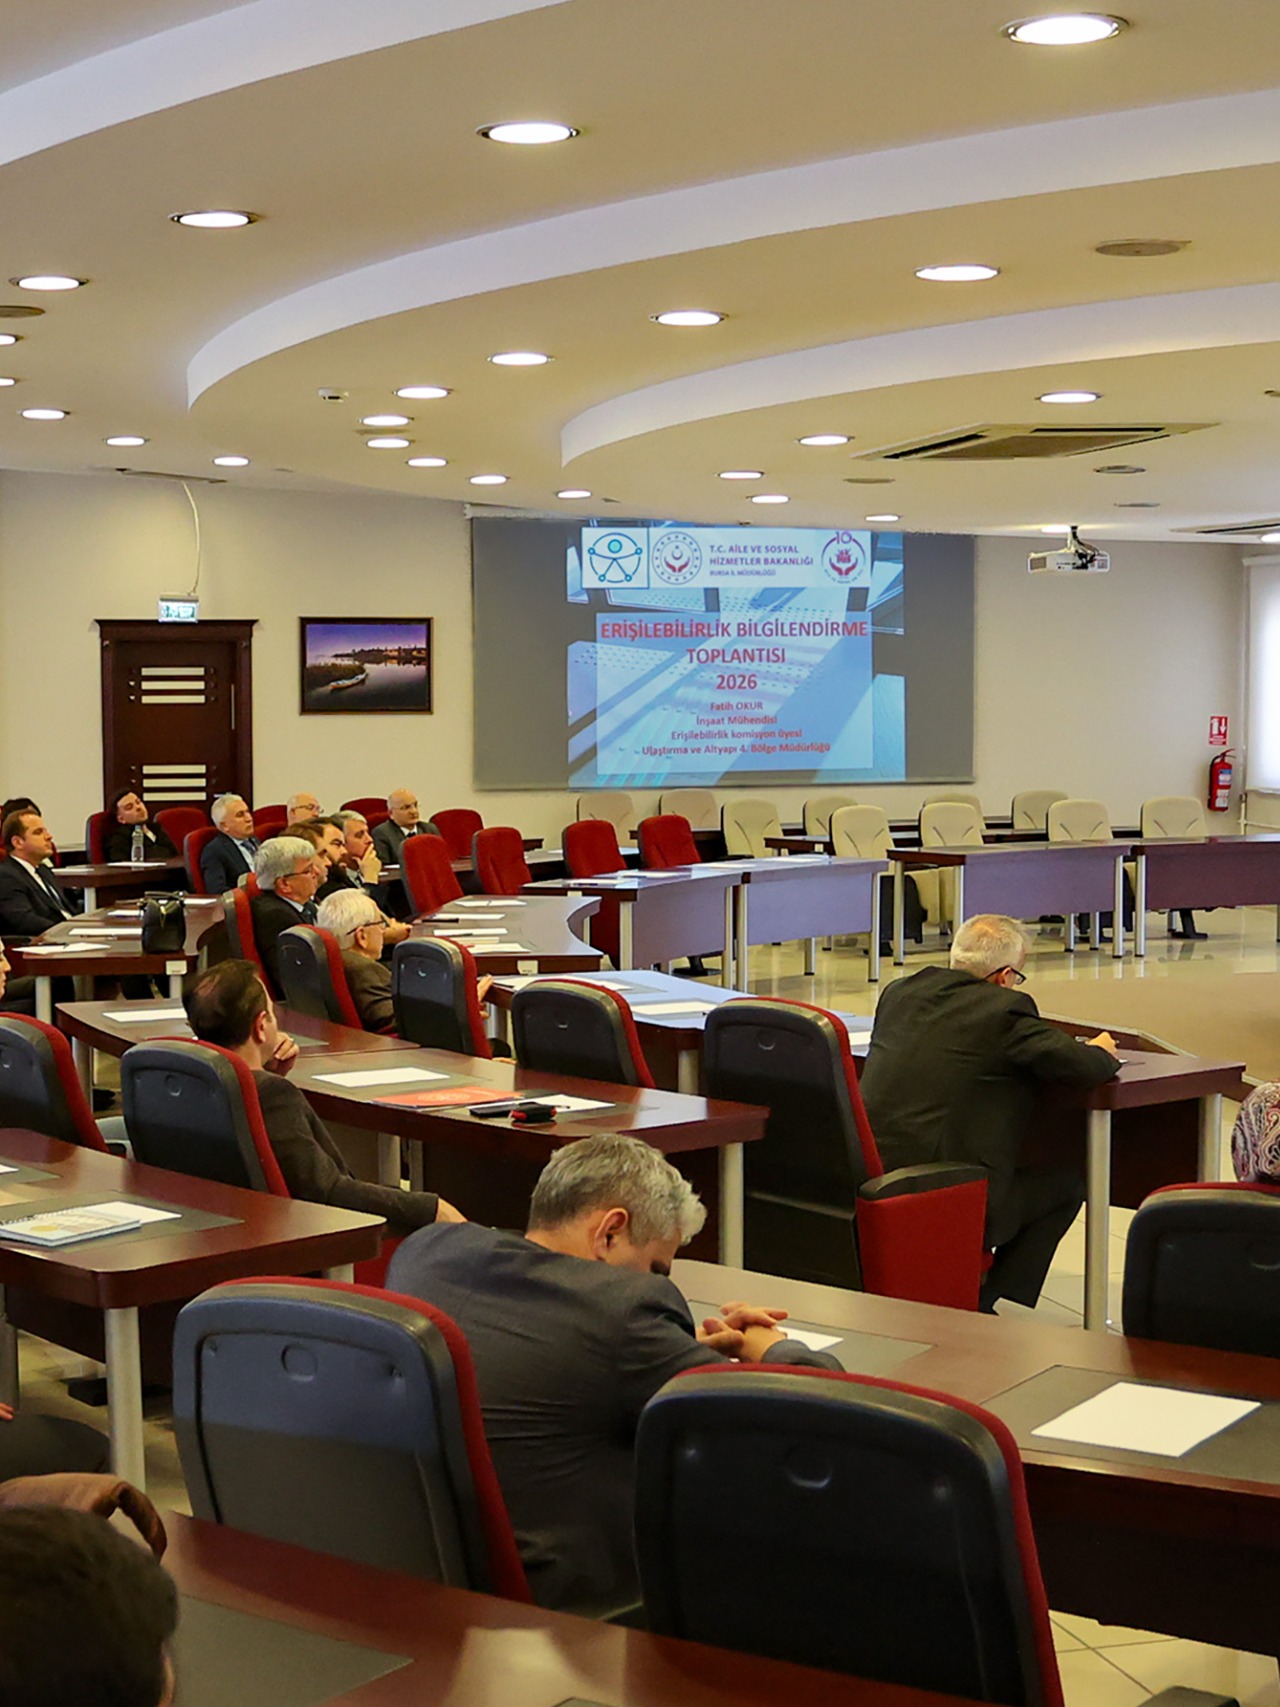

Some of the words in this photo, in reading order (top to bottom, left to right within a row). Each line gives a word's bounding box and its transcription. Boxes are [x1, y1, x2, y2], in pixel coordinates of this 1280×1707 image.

[709, 545, 726, 553] T.C.
[728, 543, 748, 553] AİLE
[750, 545, 762, 553] VE
[764, 545, 799, 553] SOSYAL
[709, 556, 761, 565] HİZMETLER
[763, 555, 814, 565] BAKANLIĞI
[601, 619, 731, 641] ERİŞİLEBİLİRLİK
[736, 618, 868, 637] BİLGİLENDİRME
[686, 648, 786, 664] TOPLANTISI
[716, 674, 757, 690] 2026
[710, 702, 733, 711] Fatih
[736, 702, 763, 710] OKUR
[696, 716, 725, 726] İnşaat
[728, 715, 777, 724] Mühendisi
[671, 731, 729, 742] Erişilebilirlik
[731, 730, 776, 741] komisyon
[778, 729, 802, 739] üyesi
[642, 746, 688, 757] Ulaştırma
[704, 745, 737, 756] Altyapı
[751, 744, 776, 755] Bölge
[779, 743, 831, 754] Müdürlüğü
